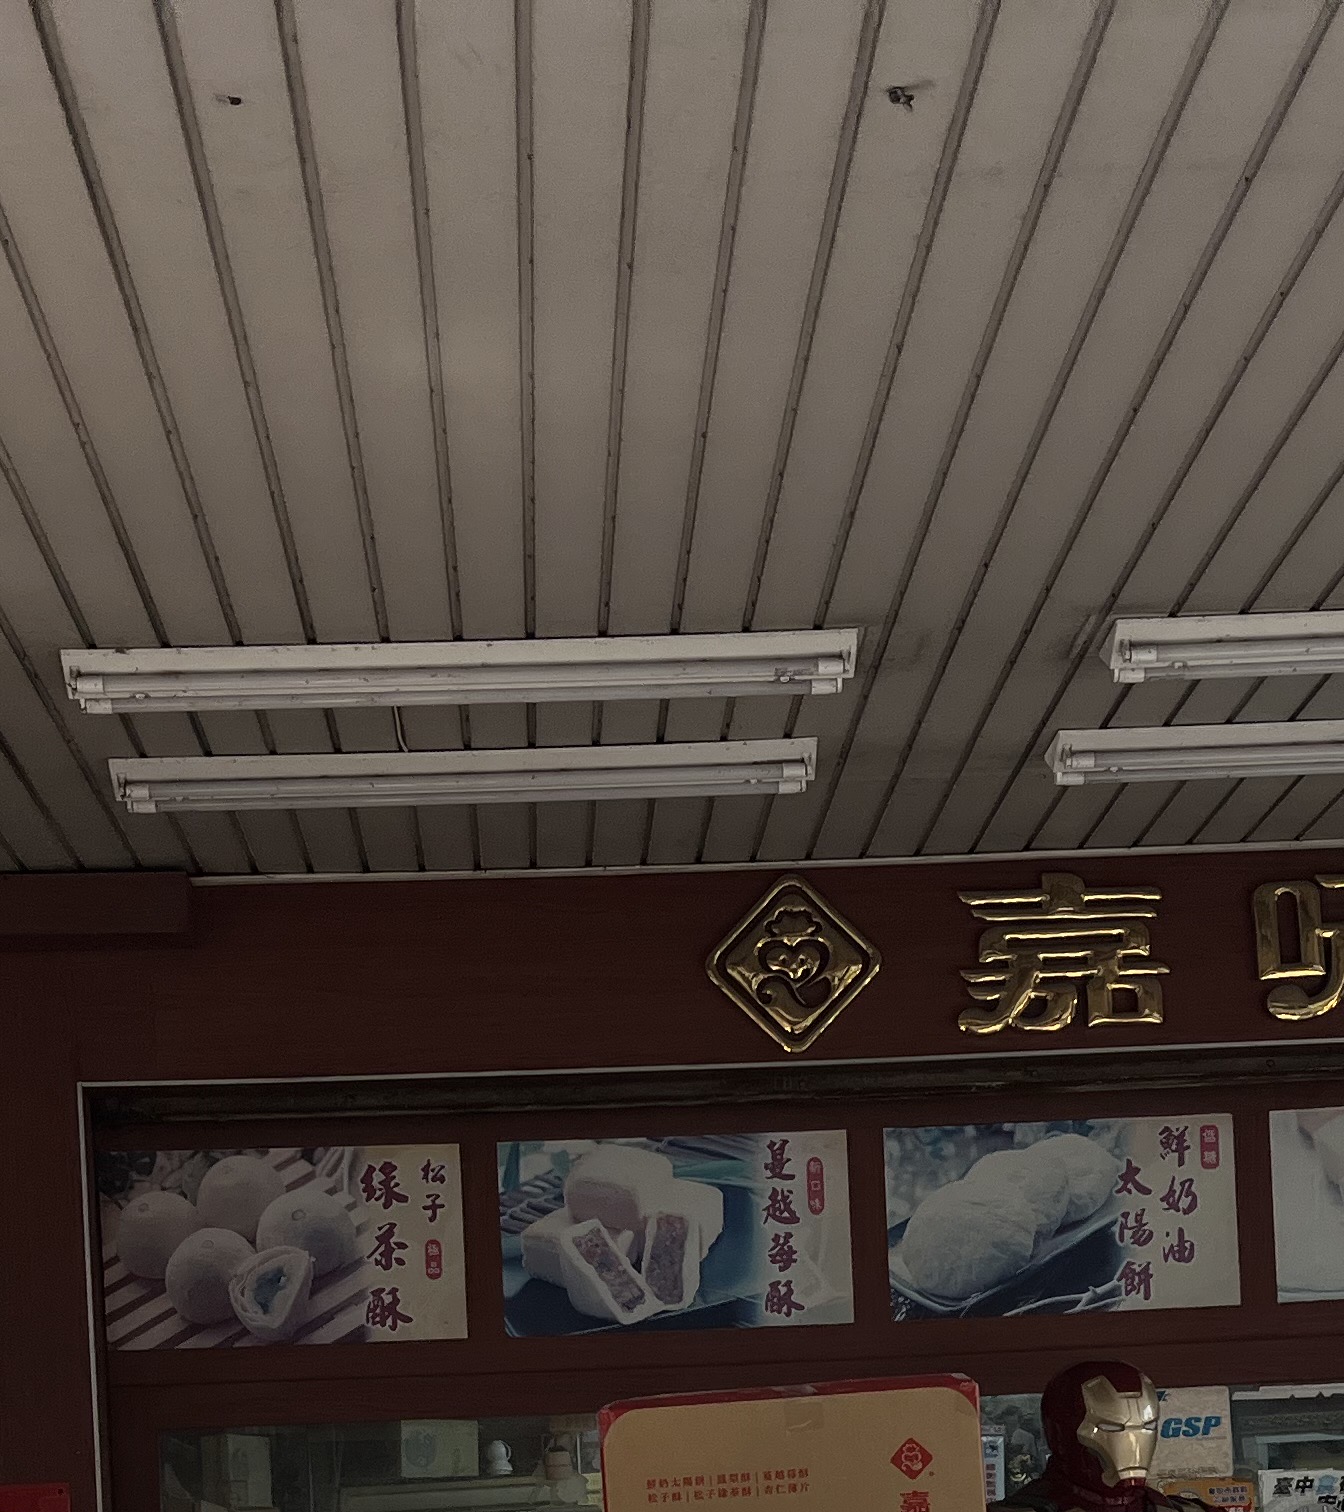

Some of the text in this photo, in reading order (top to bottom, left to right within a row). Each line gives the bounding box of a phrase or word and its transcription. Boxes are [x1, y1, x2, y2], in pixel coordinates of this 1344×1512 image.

[360, 1161, 414, 1332] 綠茶酥
[420, 1159, 447, 1222] 松子
[763, 1139, 805, 1318] 蔓越莓酥
[1116, 1158, 1154, 1300] 太陽餅
[1158, 1125, 1198, 1264] 鮮奶油
[1160, 1415, 1222, 1439] GSP
